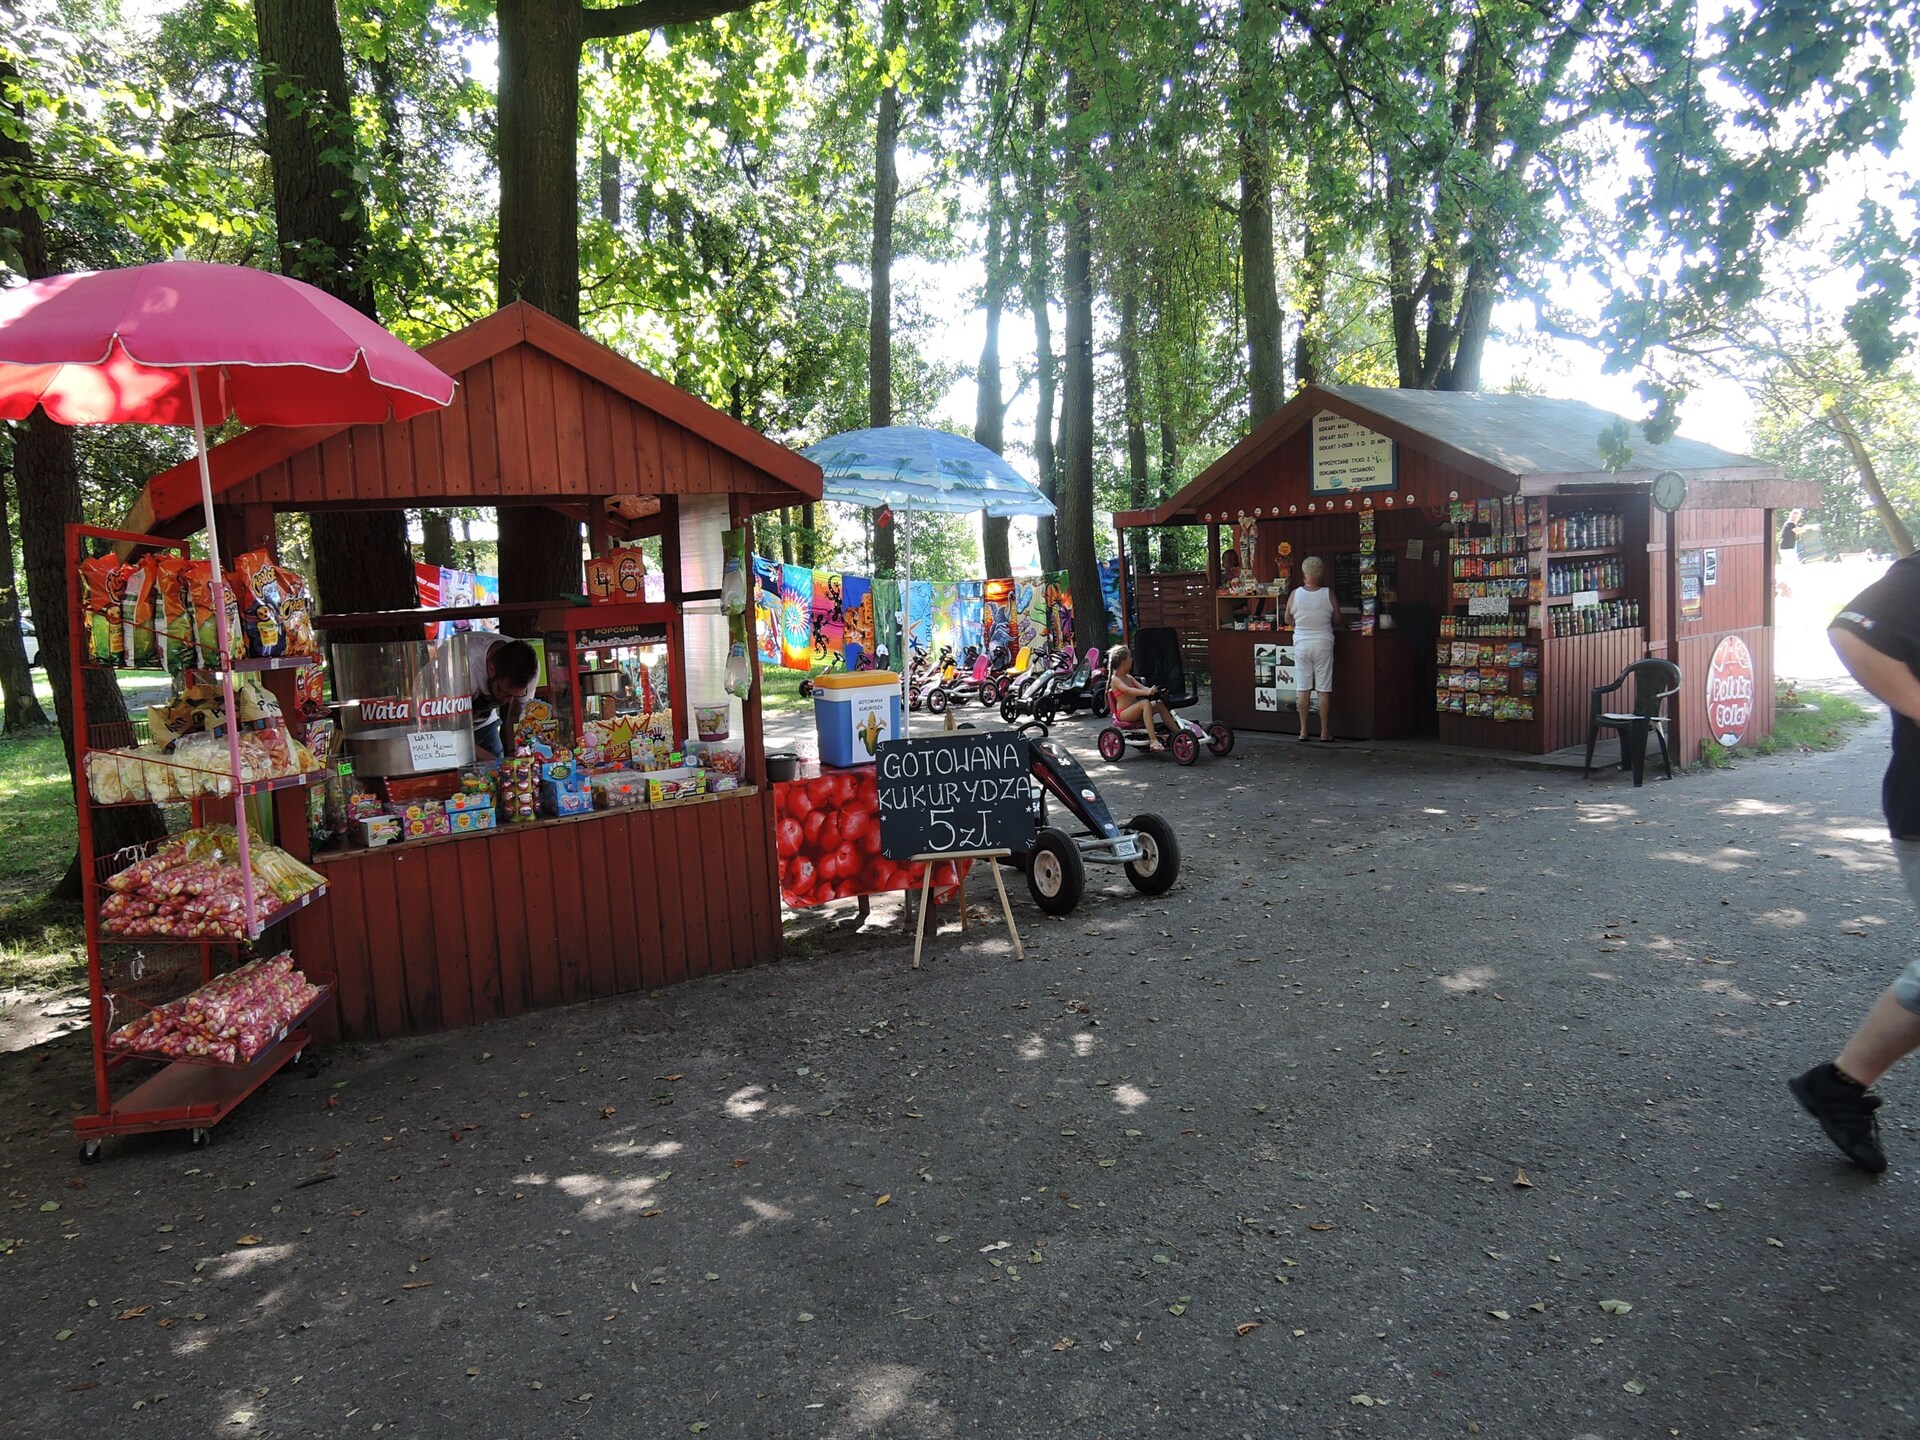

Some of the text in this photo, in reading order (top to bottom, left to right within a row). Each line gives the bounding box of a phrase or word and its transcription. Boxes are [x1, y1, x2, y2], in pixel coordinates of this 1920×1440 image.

[594, 625, 640, 635] POPCORN
[360, 702, 409, 720] Wata
[414, 733, 436, 742] WATA
[883, 743, 1020, 779] GOTOWANA
[1057, 758, 1071, 766] 56
[877, 776, 1031, 811] KUKURYDZA
[928, 806, 992, 851] 5 zł
